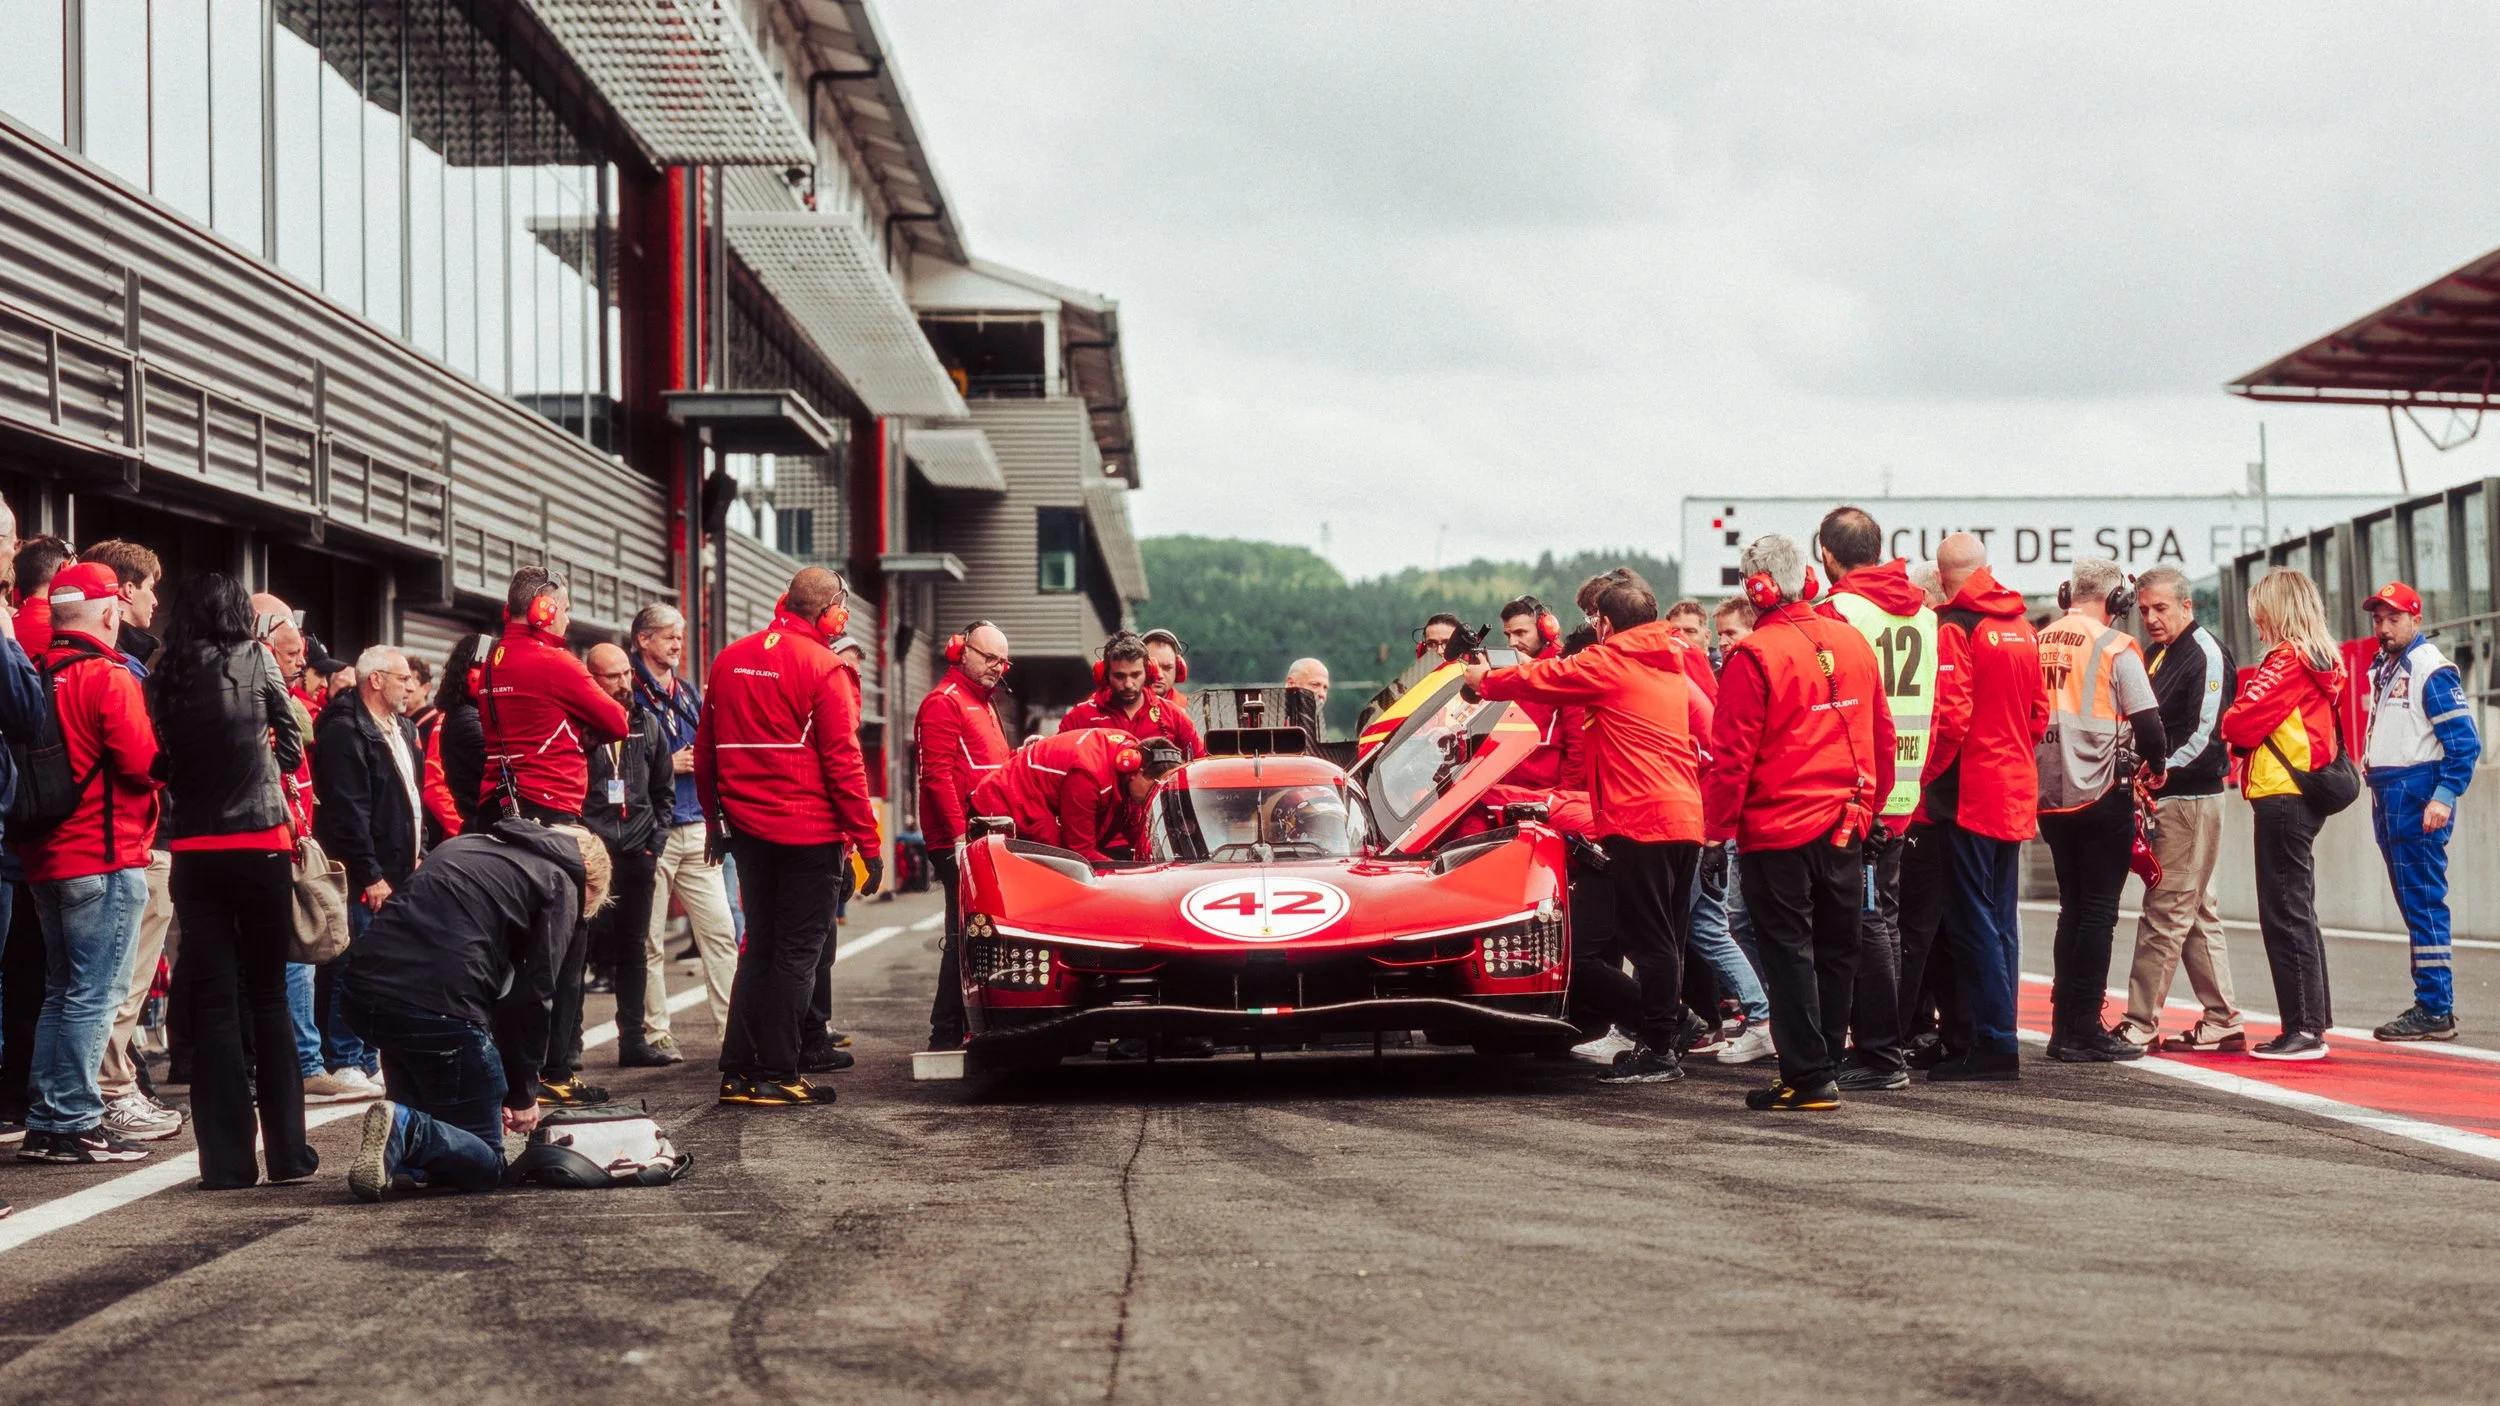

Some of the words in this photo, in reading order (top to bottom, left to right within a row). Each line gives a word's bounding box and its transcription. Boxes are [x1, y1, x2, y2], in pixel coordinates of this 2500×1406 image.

[2015, 528, 2073, 563] DE
[2096, 528, 2185, 562] SPA
[2039, 631, 2086, 647] TEWARD
[1876, 625, 1922, 696] 12
[1203, 891, 1326, 916] 42
